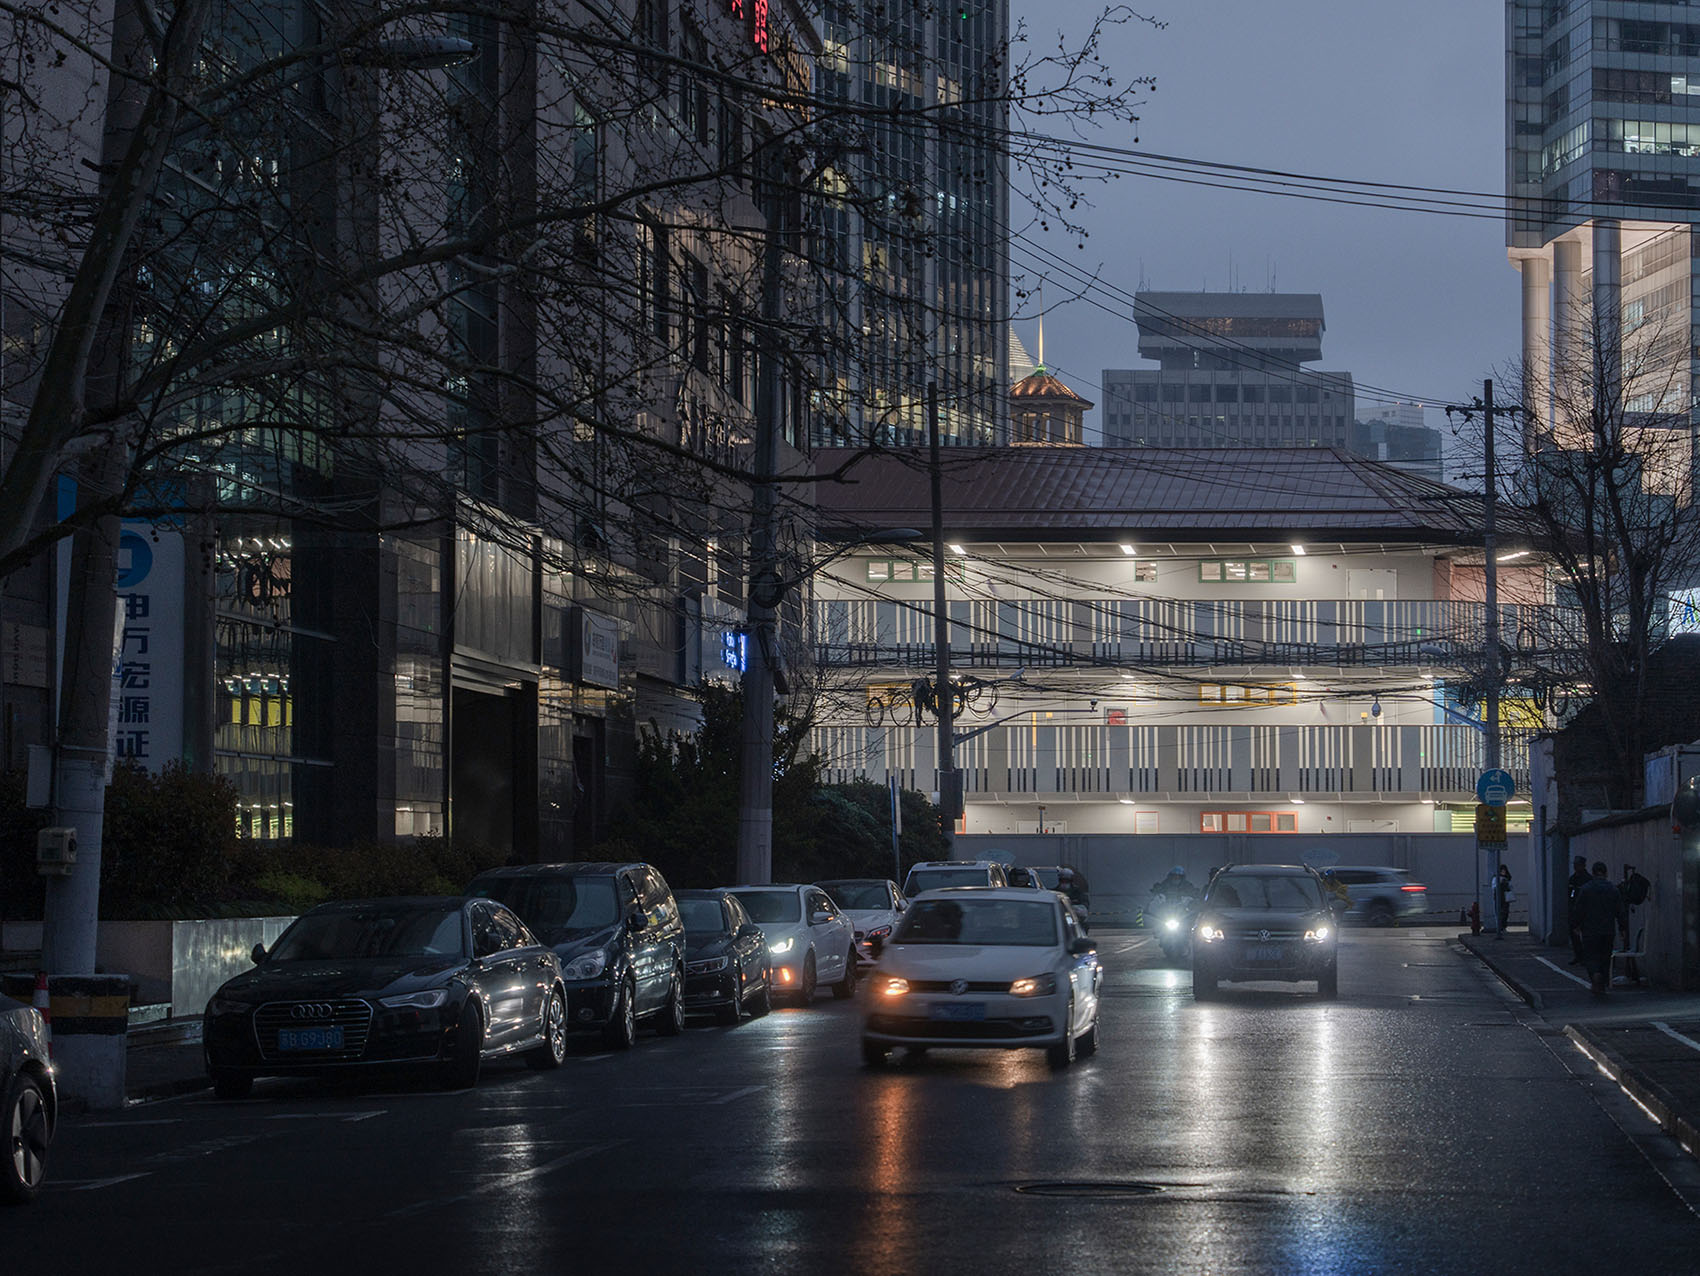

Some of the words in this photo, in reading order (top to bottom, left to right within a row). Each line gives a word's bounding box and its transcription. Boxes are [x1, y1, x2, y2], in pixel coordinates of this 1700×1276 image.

[116, 593, 150, 773] 申万宏源证
